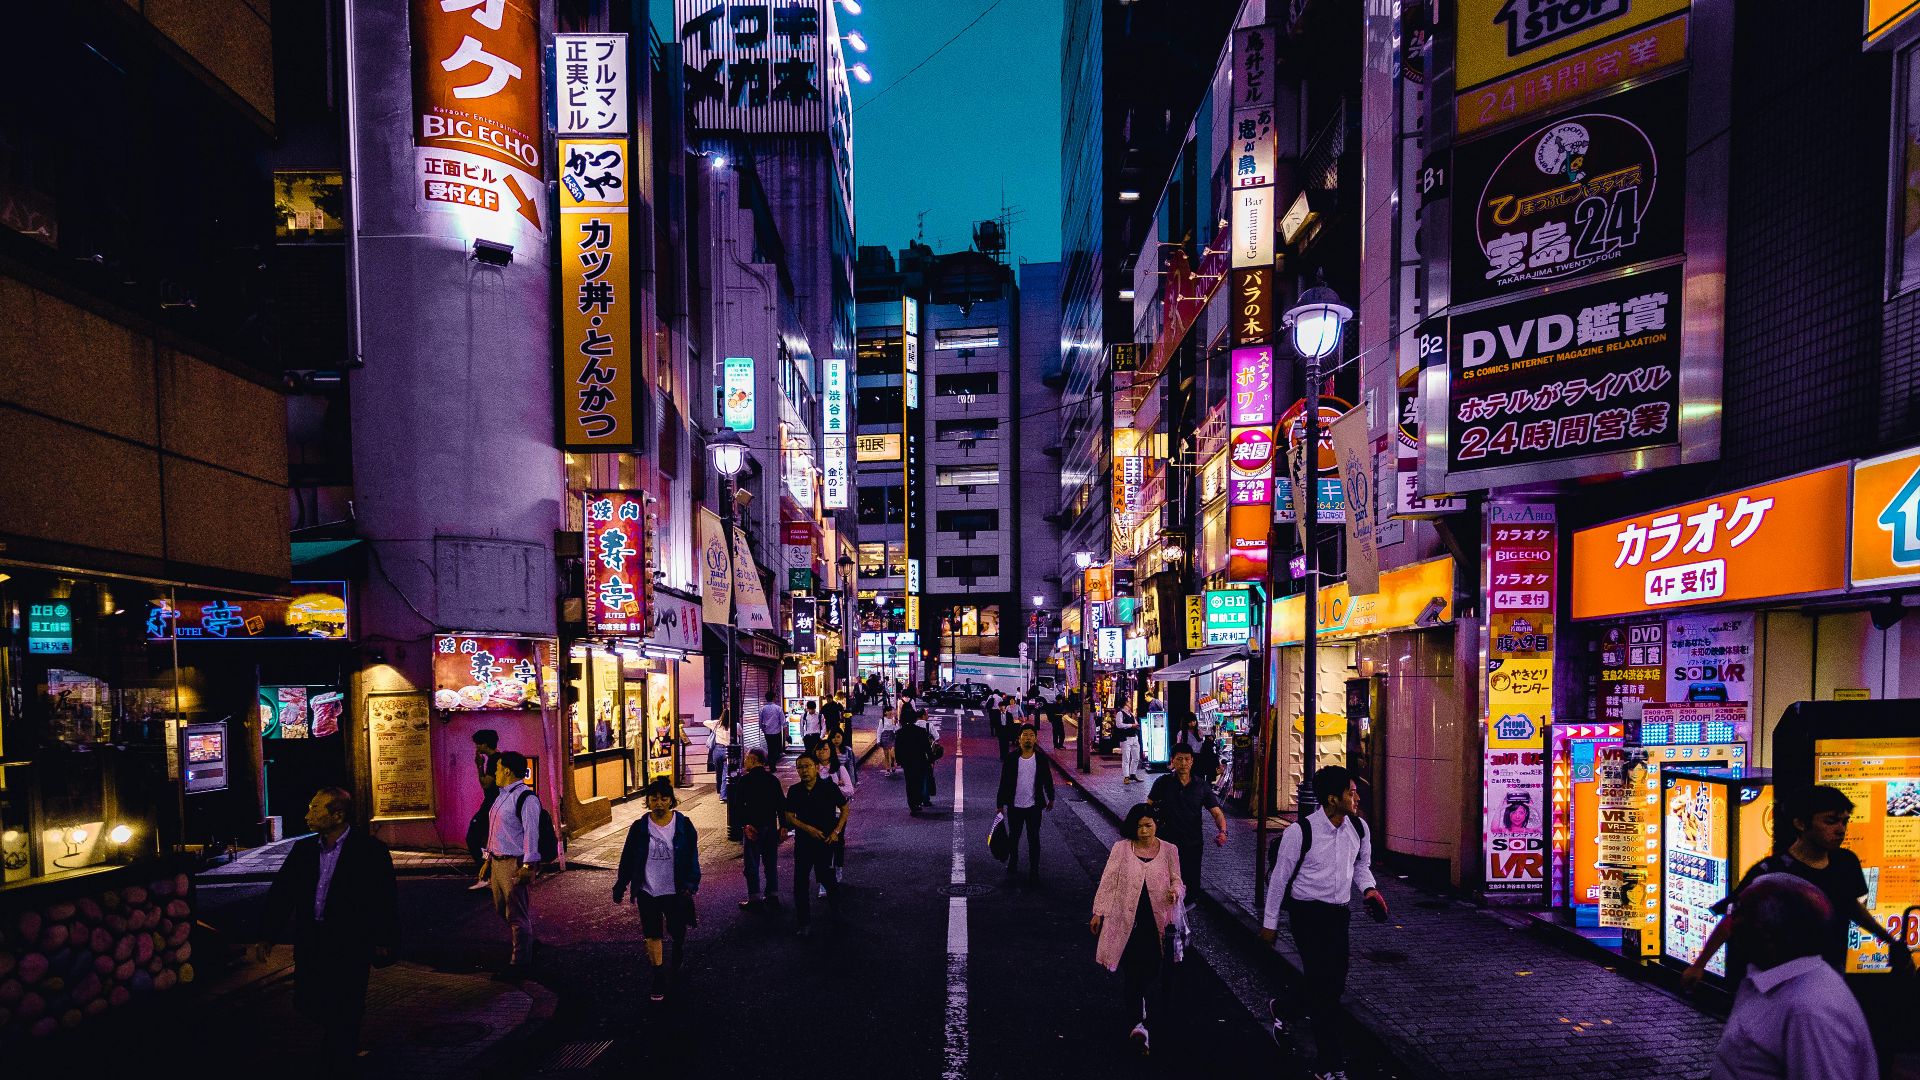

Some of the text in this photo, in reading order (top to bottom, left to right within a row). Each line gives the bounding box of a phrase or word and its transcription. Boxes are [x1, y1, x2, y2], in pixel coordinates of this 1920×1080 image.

[565, 41, 589, 131] 正実ビル
[1476, 35, 1659, 124] 24時間営業
[433, 106, 530, 140] Karaoke Entertainment
[1558, 126, 1585, 138] room
[423, 114, 539, 167] BIG ECHO
[424, 157, 498, 184] 正面ビル
[564, 147, 622, 200] かつや
[1423, 167, 1444, 194] B1
[429, 182, 497, 209] 受付4F
[1244, 197, 1264, 207] Bar
[1247, 208, 1258, 260] Geranium
[1496, 267, 1553, 287] TAKARAJIMA
[1554, 258, 1593, 272] TWENTY
[1241, 270, 1264, 335] バラの木
[577, 217, 617, 439] カツ丼・とんかつ
[1462, 291, 1670, 370] DVD鑑賞
[1420, 333, 1443, 359] B2
[1462, 333, 1667, 379] CS COMICS INTERNET MAGAZINE RELAXATION
[1457, 365, 1672, 424] ホテルがライバル
[1457, 401, 1671, 460] 24時間営業
[859, 438, 884, 451] 和民
[1232, 441, 1272, 461] 楽園
[1236, 489, 1265, 502] 右折
[592, 498, 640, 521] 焼肉
[1496, 529, 1550, 541] カラオケ
[1614, 496, 1775, 569] カラオケ
[1495, 549, 1551, 562] BIG ECHO
[1494, 573, 1550, 585] カラオケ
[1650, 566, 1718, 597] 4F 受付
[1224, 595, 1247, 607] 日立
[1498, 594, 1545, 606] 4F 受付
[629, 622, 641, 631] B1
[1190, 598, 1201, 647] スペアーキー
[1631, 627, 1661, 643] DVD
[439, 637, 477, 654] 焼肉
[1631, 647, 1660, 665] 鑑賞
[1489, 661, 1501, 669] 2F
[1511, 669, 1548, 681] やきとり
[1602, 669, 1661, 681] 宝島24渋谷本店
[1511, 683, 1550, 695] センター
[1613, 684, 1645, 695] 全室防音
[1503, 721, 1526, 729] MINI
[1643, 715, 1674, 723] 1500円
[1679, 714, 1711, 722] 2000円
[1715, 713, 1746, 721] 2500円
[1502, 728, 1527, 737] STOP
[1741, 787, 1758, 801] 2F
[1602, 810, 1626, 822] VR
[1491, 838, 1544, 851] SOD
[1490, 852, 1544, 879] VR
[1601, 869, 1623, 881] VR
